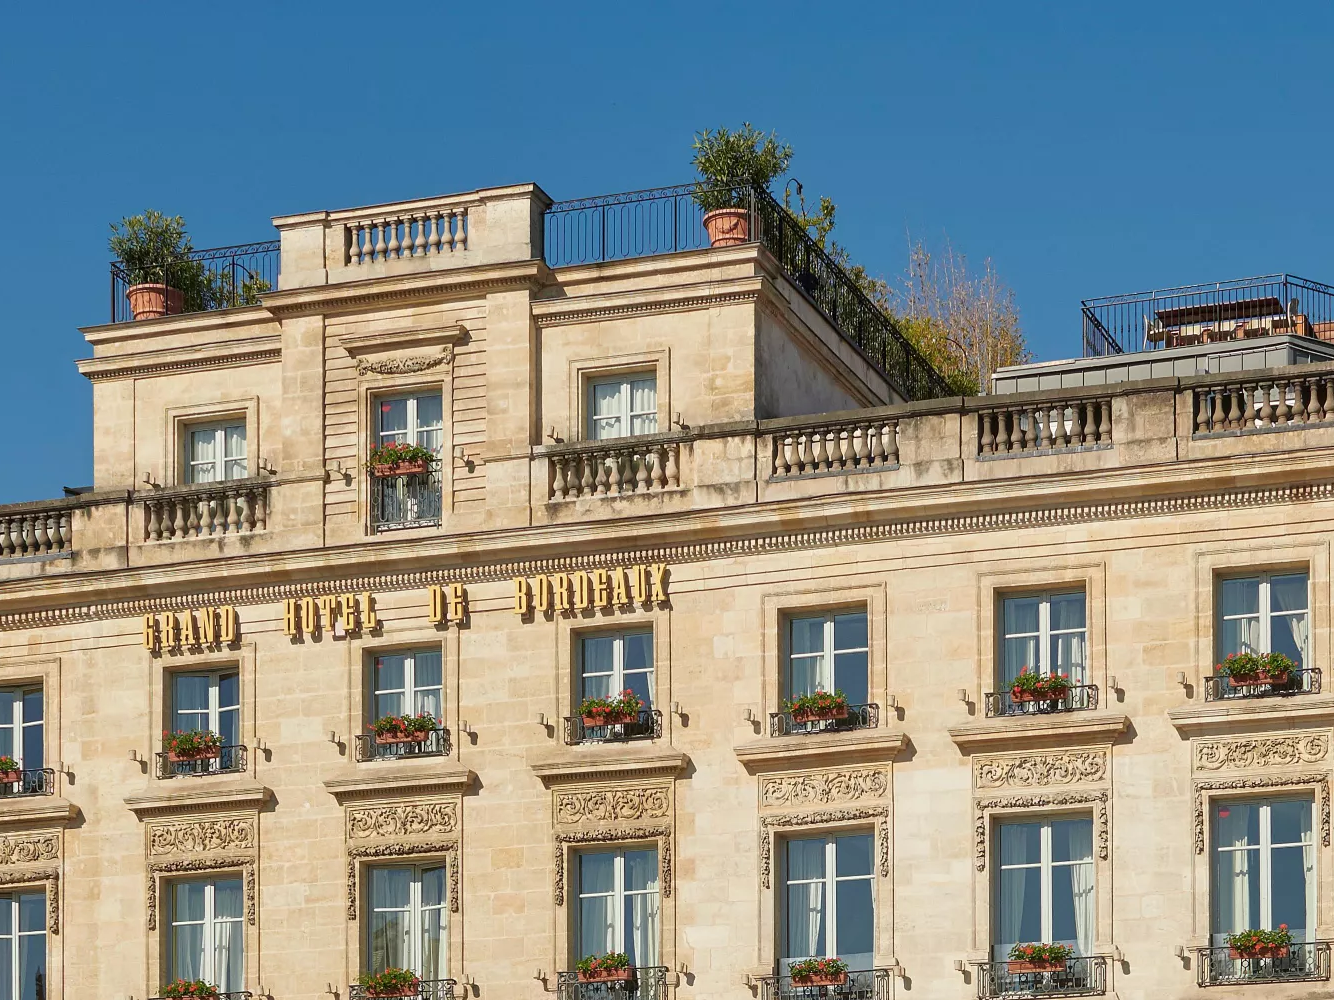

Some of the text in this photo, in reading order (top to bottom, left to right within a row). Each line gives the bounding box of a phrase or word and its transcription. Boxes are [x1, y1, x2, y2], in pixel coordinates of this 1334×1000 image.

[143, 564, 667, 650] GRAND HOTEL DE BORDEAUX
